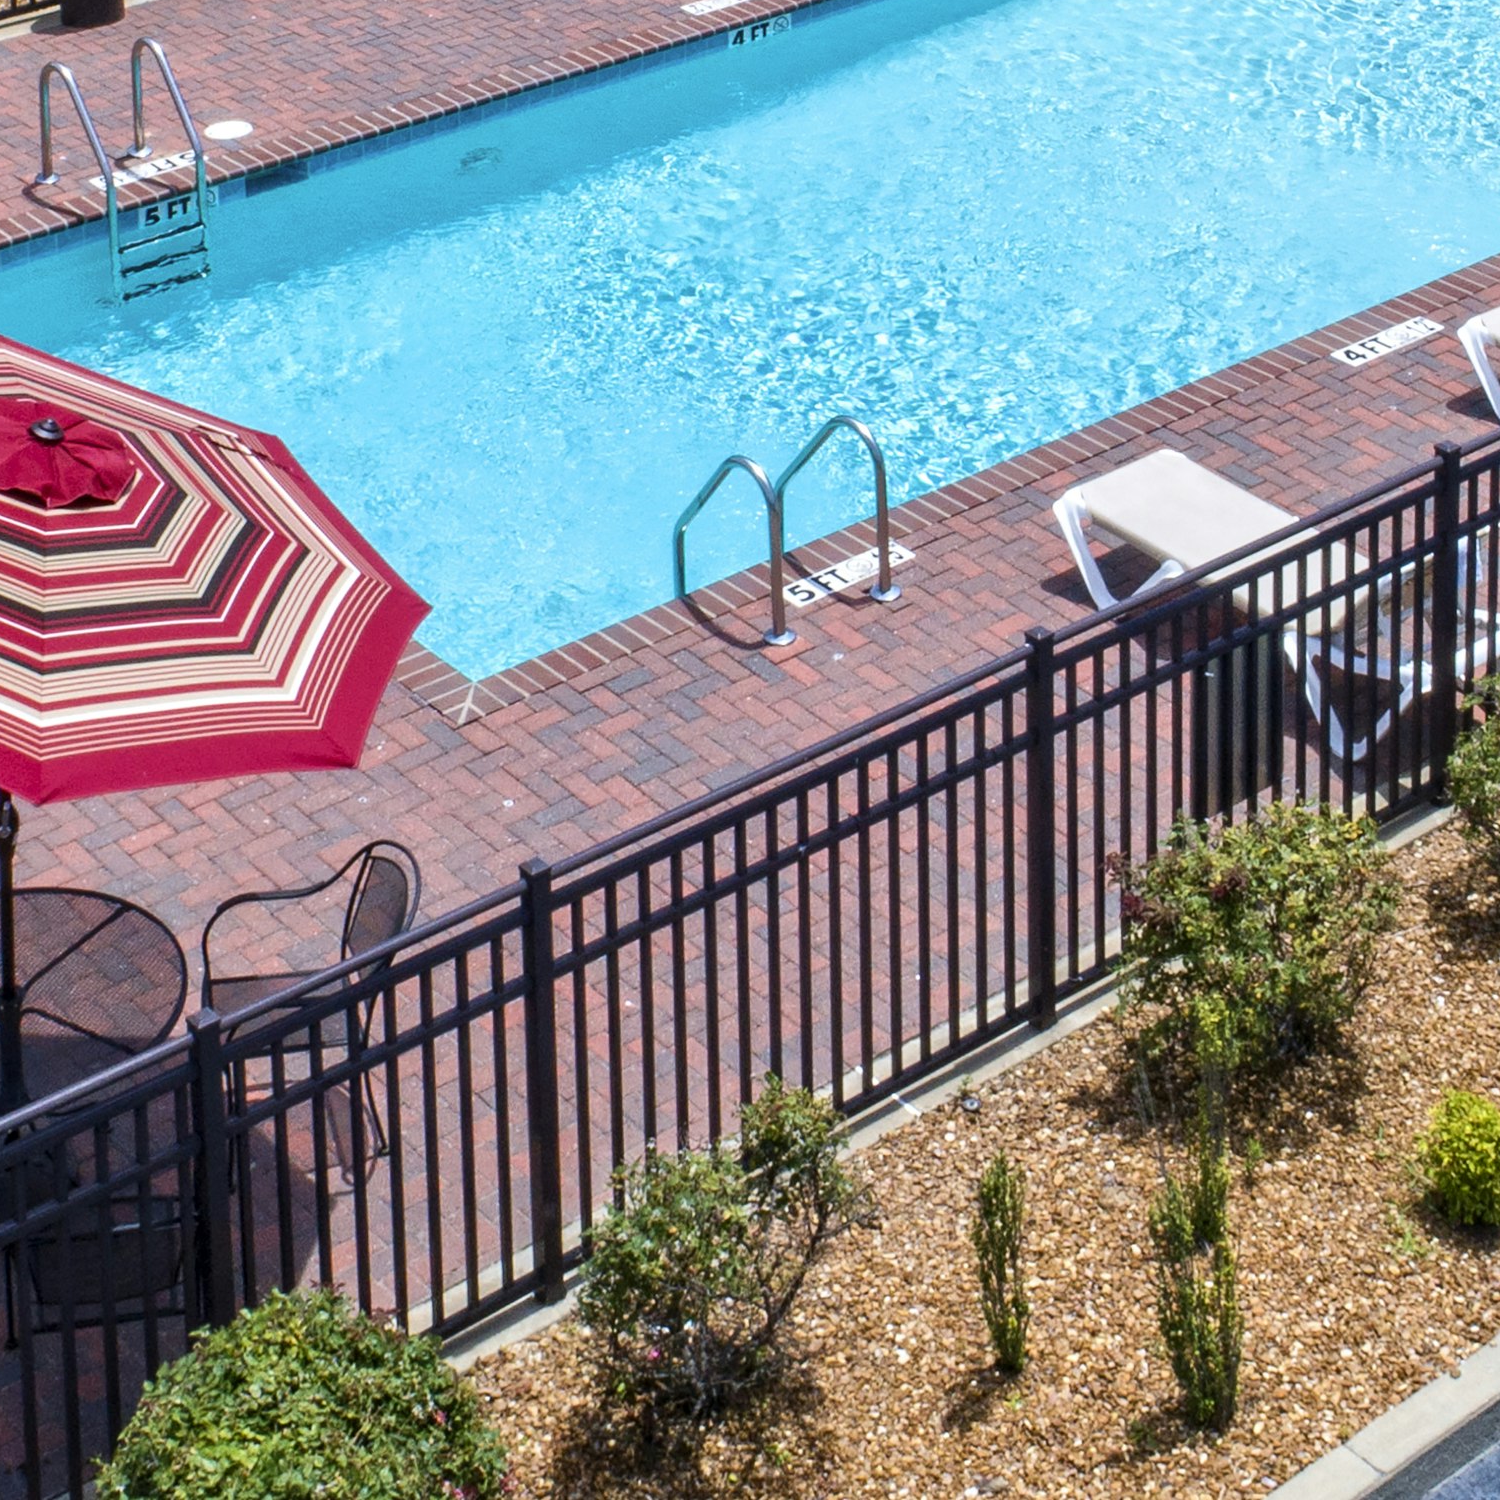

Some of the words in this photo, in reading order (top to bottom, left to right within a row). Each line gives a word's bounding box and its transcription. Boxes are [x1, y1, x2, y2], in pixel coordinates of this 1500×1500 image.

[732, 30, 745, 45] 4
[750, 22, 769, 42] FT
[150, 158, 178, 171] FT
[145, 207, 160, 226] 5
[167, 196, 190, 219] FT
[1343, 349, 1367, 361] 4
[1358, 337, 1393, 354] FT
[787, 585, 816, 602] 5
[810, 569, 849, 592] FT
